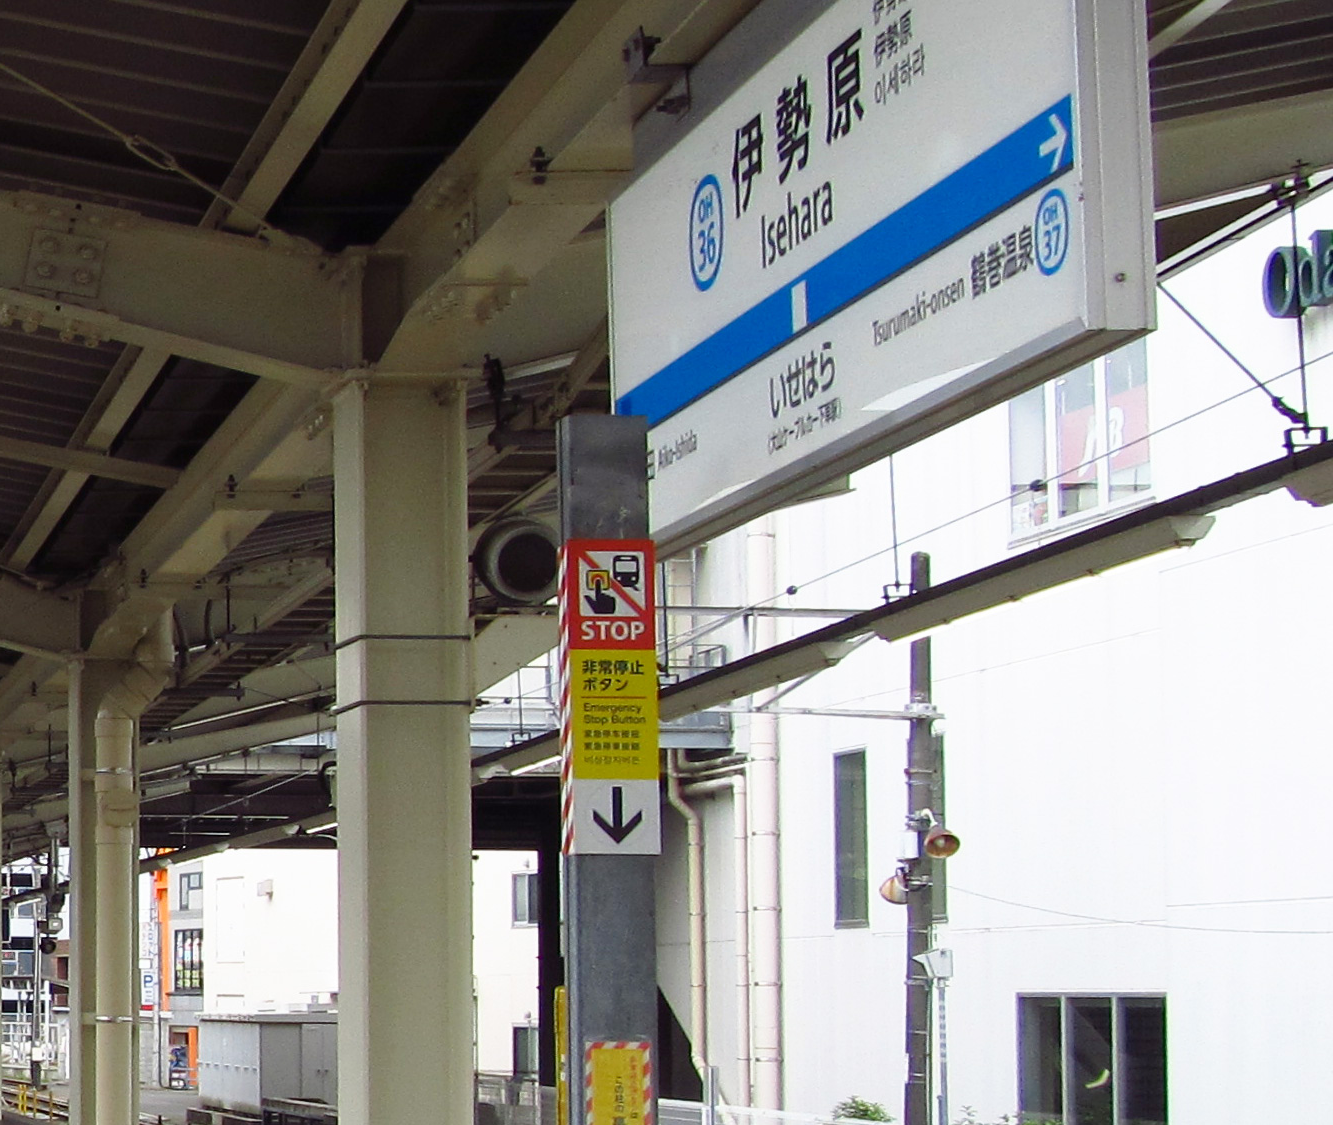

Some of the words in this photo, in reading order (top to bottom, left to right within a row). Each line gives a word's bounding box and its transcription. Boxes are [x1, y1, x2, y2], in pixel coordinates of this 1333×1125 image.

[874, 43, 925, 105] 이세하라
[732, 28, 864, 218] 伊勢原
[698, 191, 714, 223] OH
[1043, 202, 1058, 226] OH
[762, 181, 833, 268] Isehara
[697, 224, 717, 273] 36
[1042, 224, 1062, 263] 37
[871, 277, 966, 347] Tsurumaki-onsen
[769, 342, 835, 419] いせはら
[581, 620, 645, 641] STOP
[582, 659, 645, 676] 非常停止
[583, 677, 629, 692] ボタン
[583, 702, 642, 715] Emergency
[583, 714, 609, 726] Stop
[611, 714, 647, 725] Button
[143, 974, 153, 988] P
